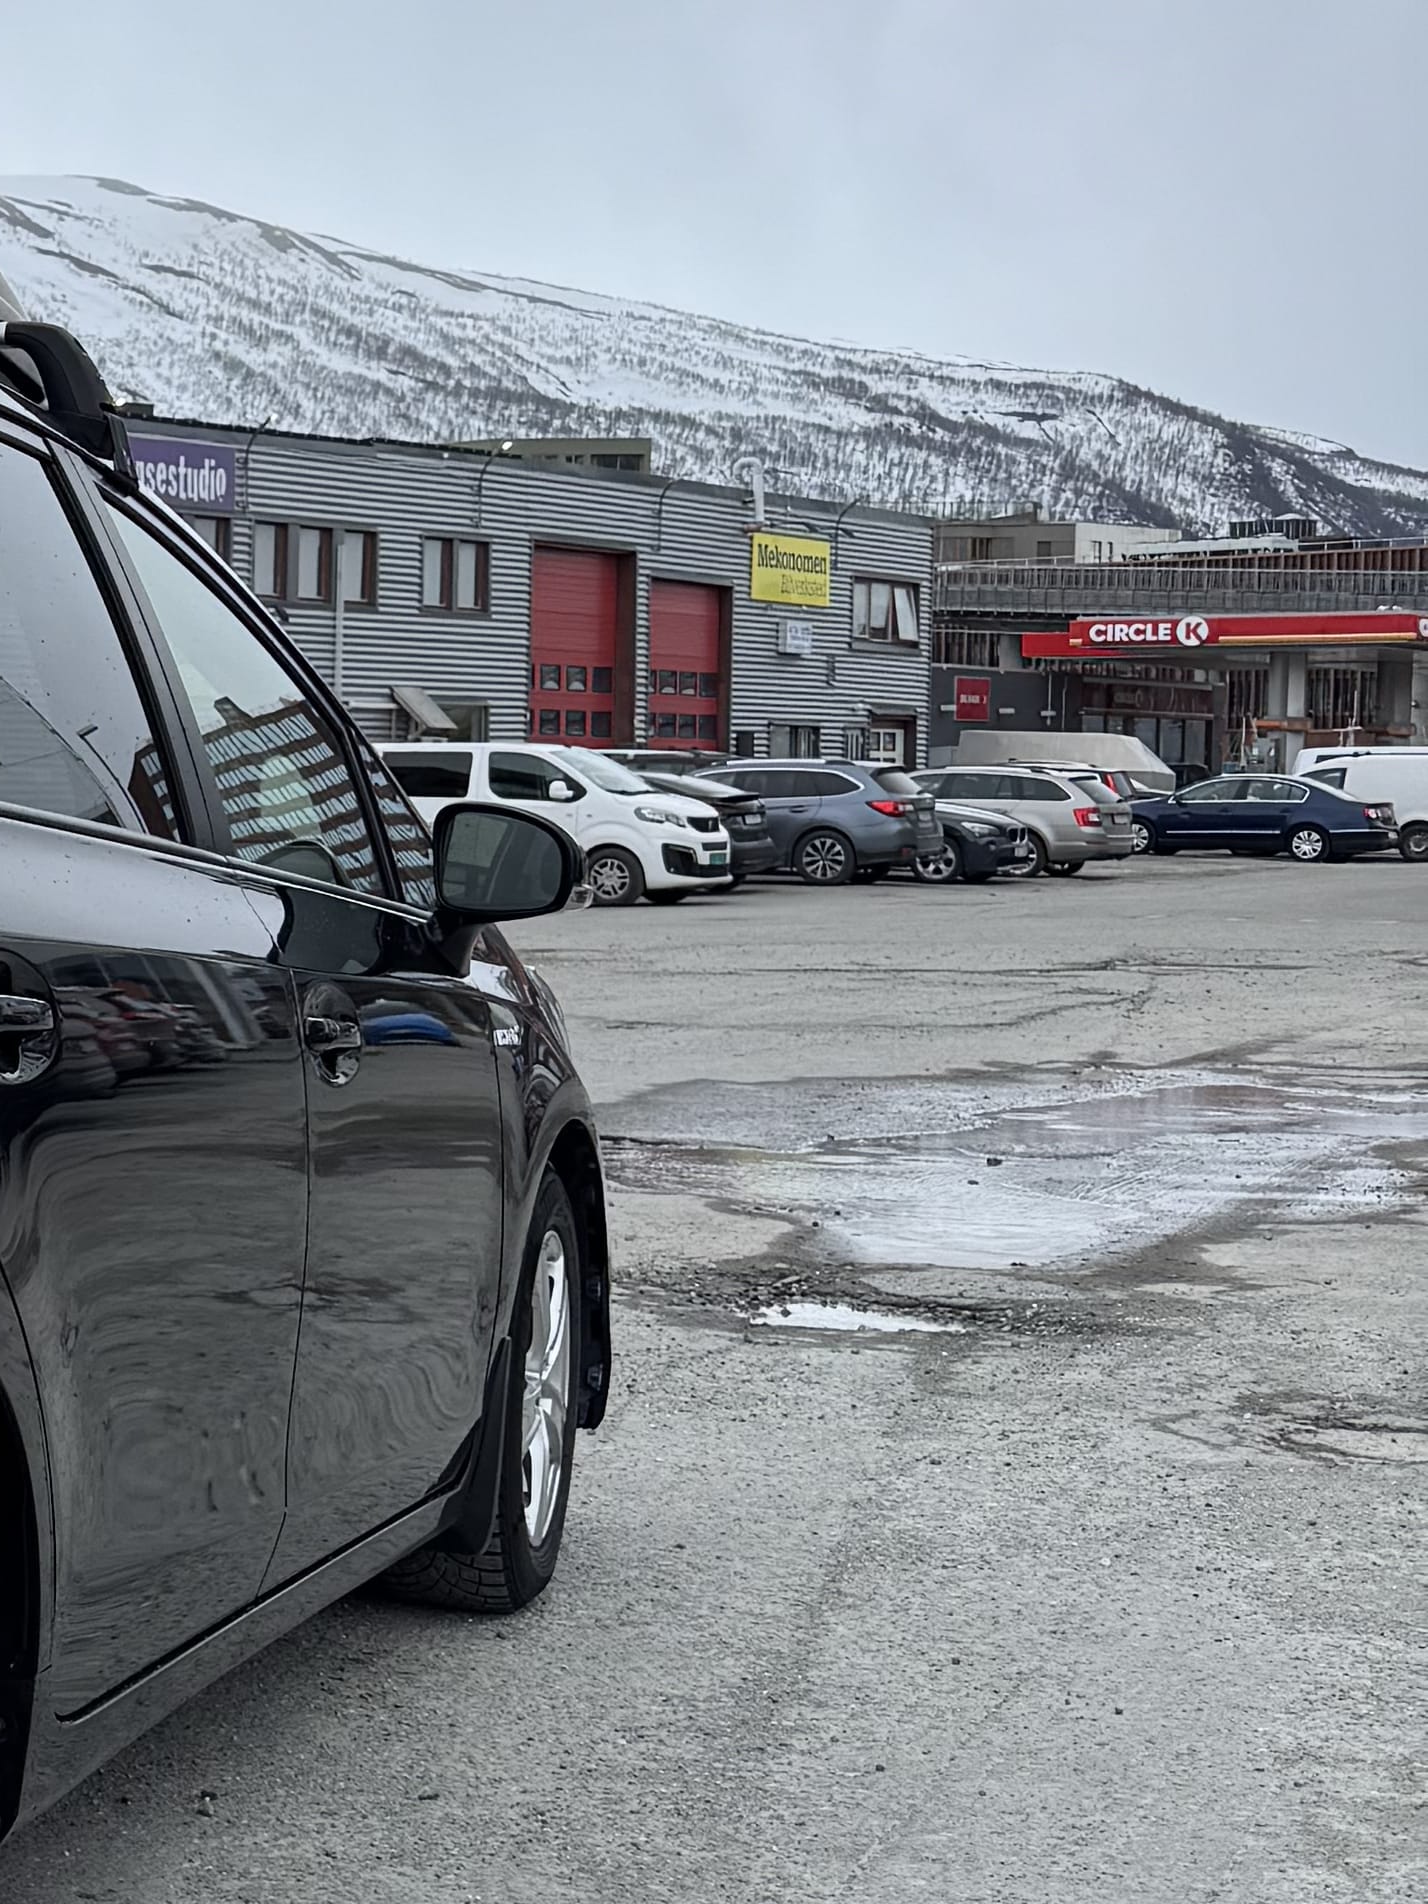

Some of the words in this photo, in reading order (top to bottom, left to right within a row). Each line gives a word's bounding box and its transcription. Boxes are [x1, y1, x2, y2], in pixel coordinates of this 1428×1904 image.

[757, 543, 827, 575] Mekonomen
[1088, 623, 1172, 643] CIRCLE
[1182, 620, 1206, 645] K
